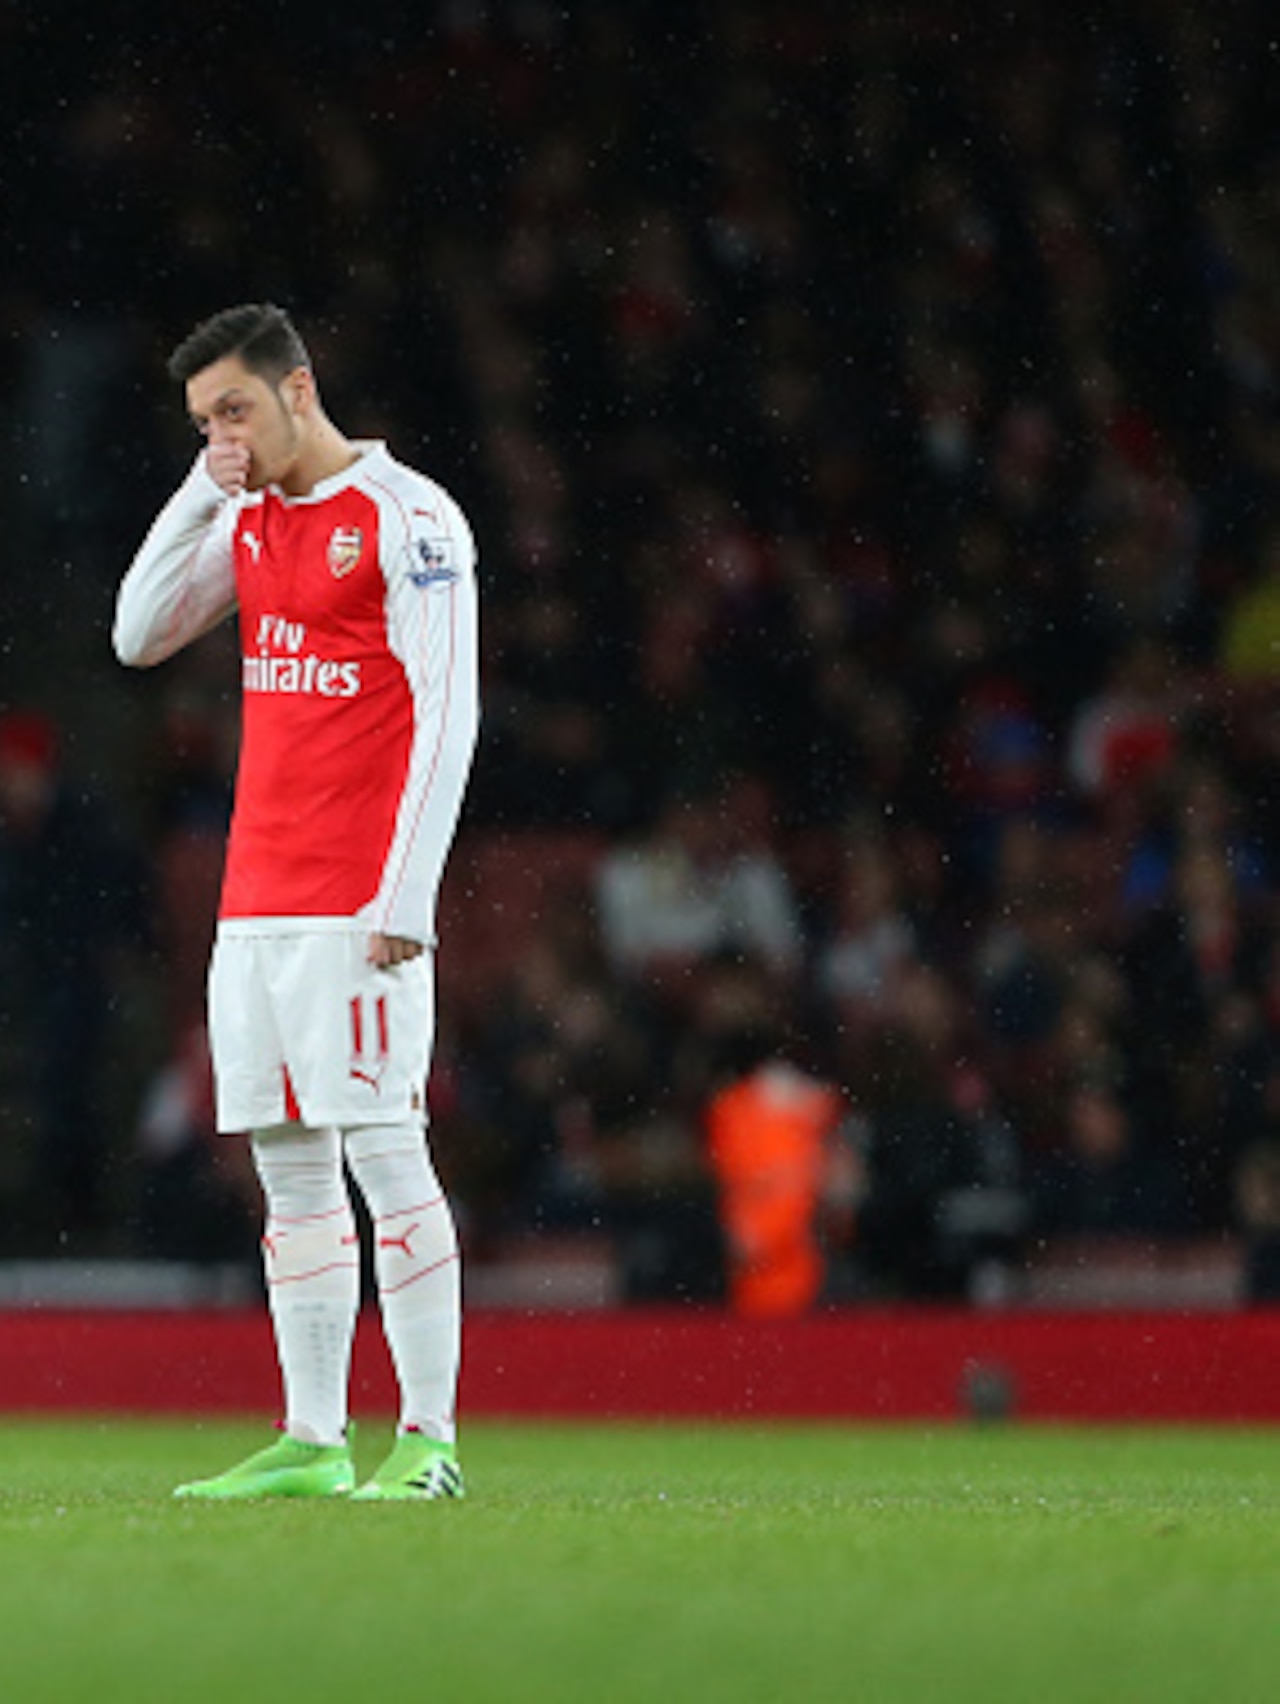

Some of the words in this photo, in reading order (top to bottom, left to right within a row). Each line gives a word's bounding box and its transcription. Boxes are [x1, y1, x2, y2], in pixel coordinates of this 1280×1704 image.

[255, 613, 305, 653] Fly
[243, 647, 361, 696] mirates
[350, 994, 388, 1060] 11
